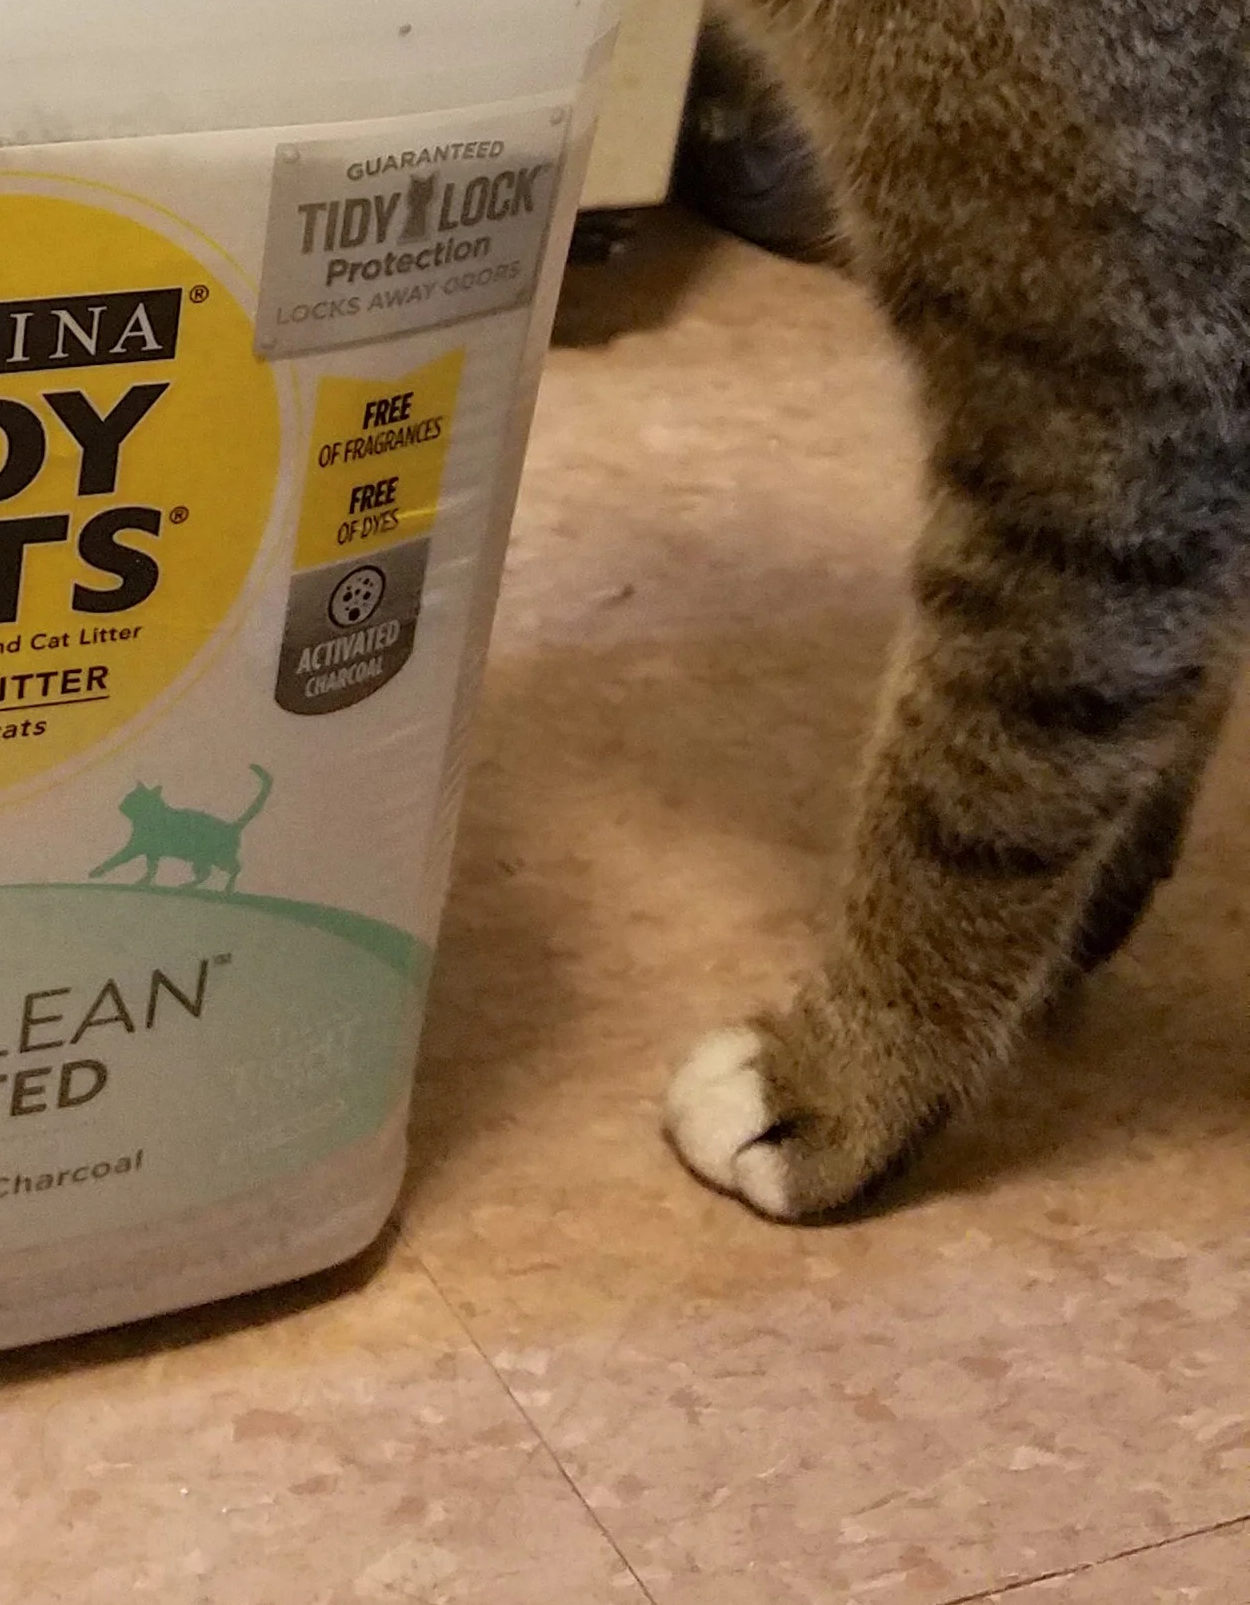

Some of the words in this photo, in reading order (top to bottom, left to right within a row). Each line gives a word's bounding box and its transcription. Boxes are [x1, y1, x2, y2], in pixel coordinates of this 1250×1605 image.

[347, 141, 504, 181] GUARANTEED
[299, 192, 402, 255] TIDY
[438, 165, 540, 232] LOCK
[326, 236, 492, 287] Protection
[276, 296, 361, 326] LOCKS
[367, 279, 442, 313] AWAY
[362, 392, 414, 430] FREE
[318, 442, 342, 468] OF
[343, 415, 444, 464] FRAGRANCES
[349, 476, 399, 515] FREE
[336, 520, 359, 546] OF
[359, 508, 399, 539] DYES
[30, 630, 70, 651] Cat
[79, 625, 143, 645] Litter
[297, 619, 400, 675] ACTIVATED
[304, 655, 386, 699] CHARCOAL
